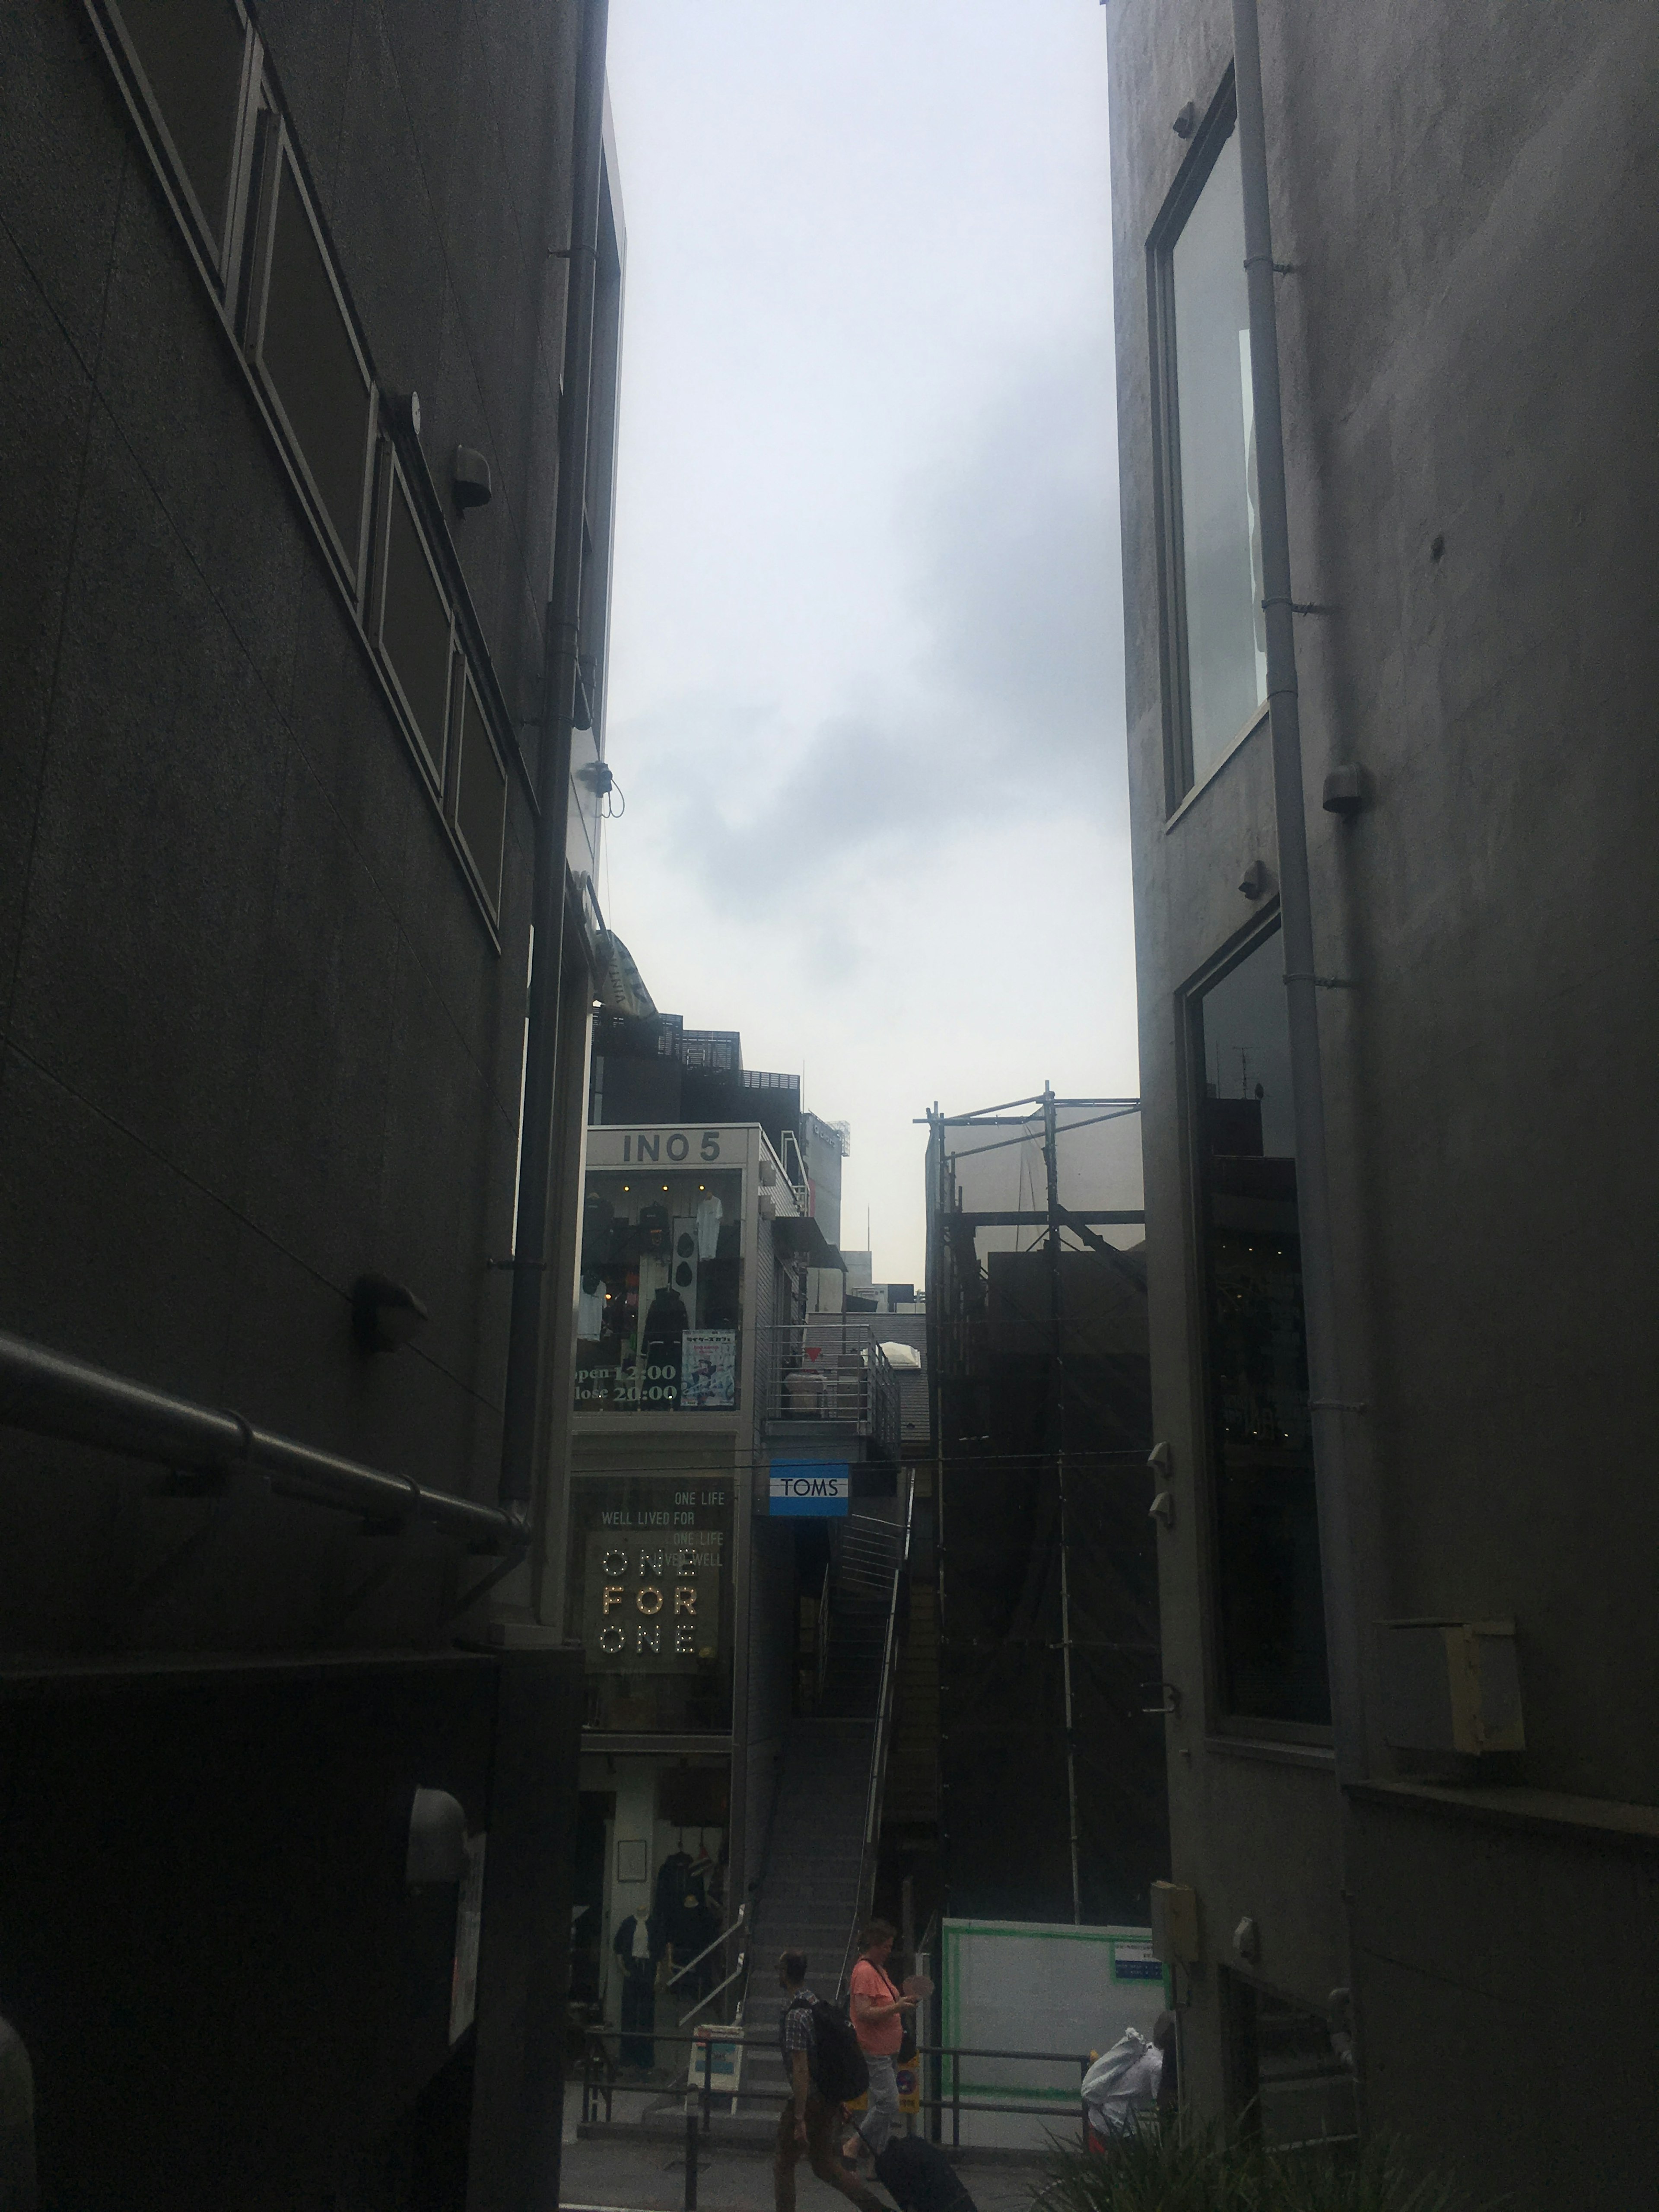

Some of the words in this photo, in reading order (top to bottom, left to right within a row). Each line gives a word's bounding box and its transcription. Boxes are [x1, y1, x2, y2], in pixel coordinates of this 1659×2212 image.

[623, 1133, 690, 1162] INO
[700, 1131, 721, 1161] 5
[614, 1365, 676, 1381] 12:00
[575, 1386, 608, 1400] lose
[613, 1386, 677, 1401] 20:00
[780, 1478, 838, 1496] TOMS
[675, 1492, 696, 1505] ONE
[701, 1492, 725, 1505] LIFE
[602, 1511, 632, 1525] WELL
[638, 1511, 670, 1525] LIVED
[674, 1511, 695, 1525] FOR
[674, 1532, 694, 1545] ONE
[700, 1532, 724, 1545] LIFE
[602, 1549, 696, 1578] ONE
[693, 1553, 723, 1567] WELL
[602, 1586, 697, 1615] FOR
[600, 1624, 696, 1655] ONE
